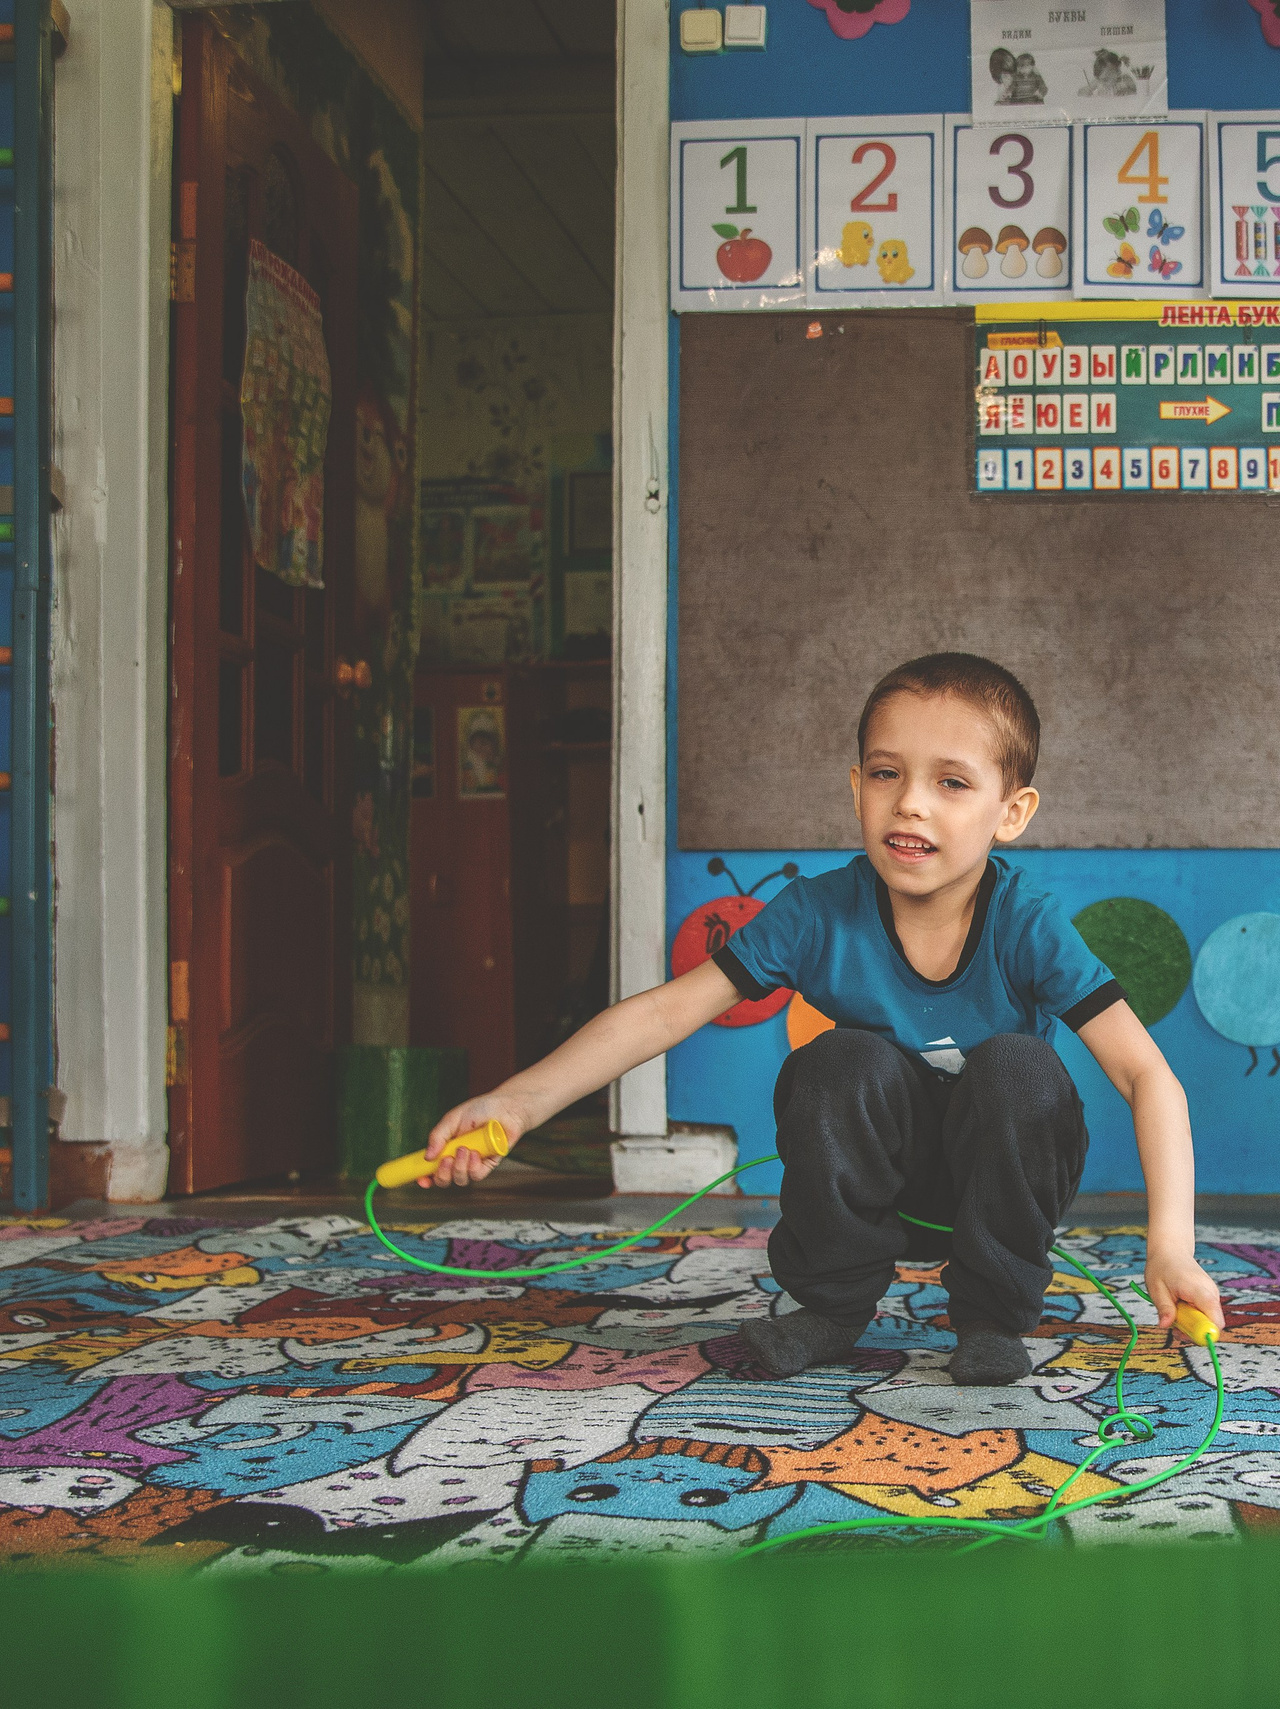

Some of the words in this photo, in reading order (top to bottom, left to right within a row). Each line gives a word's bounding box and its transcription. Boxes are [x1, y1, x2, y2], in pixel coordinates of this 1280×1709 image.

[1048, 10, 1086, 23] БУКВЫ
[1002, 29, 1032, 40] ВИДИМ
[1100, 26, 1133, 36] ПИШЕМ
[720, 146, 757, 214] 1
[851, 142, 897, 212] 2
[989, 133, 1034, 208] 3
[1118, 131, 1168, 203] 4
[1161, 306, 1231, 325] ЛЕНТА
[1000, 336, 1046, 346] ГЛАСНЫ
[985, 355, 1000, 379] А
[1014, 355, 1027, 378] О
[1042, 354, 1057, 378] У
[1070, 354, 1081, 377] Э
[1094, 355, 1114, 377] Ы
[1126, 349, 1141, 377] Й
[1155, 353, 1169, 377] Р
[1180, 353, 1197, 377] Л
[1209, 353, 1227, 377] М
[1239, 353, 1254, 377] Н
[985, 405, 1000, 428] Я
[1012, 398, 1024, 428] Ё
[1036, 404, 1058, 428] Ю
[1070, 403, 1082, 427] Е
[1097, 403, 1110, 426] И
[1174, 407, 1210, 416] ГЛУХИЕ
[1015, 460, 1022, 480] 1
[1042, 460, 1054, 479] 2
[1072, 460, 1083, 479] 3
[1100, 460, 1113, 479] 4
[1131, 459, 1141, 478] 5
[1159, 459, 1170, 479] 6
[1189, 459, 1199, 478] 7
[1217, 459, 1229, 479] 8
[1247, 459, 1257, 478] 9
